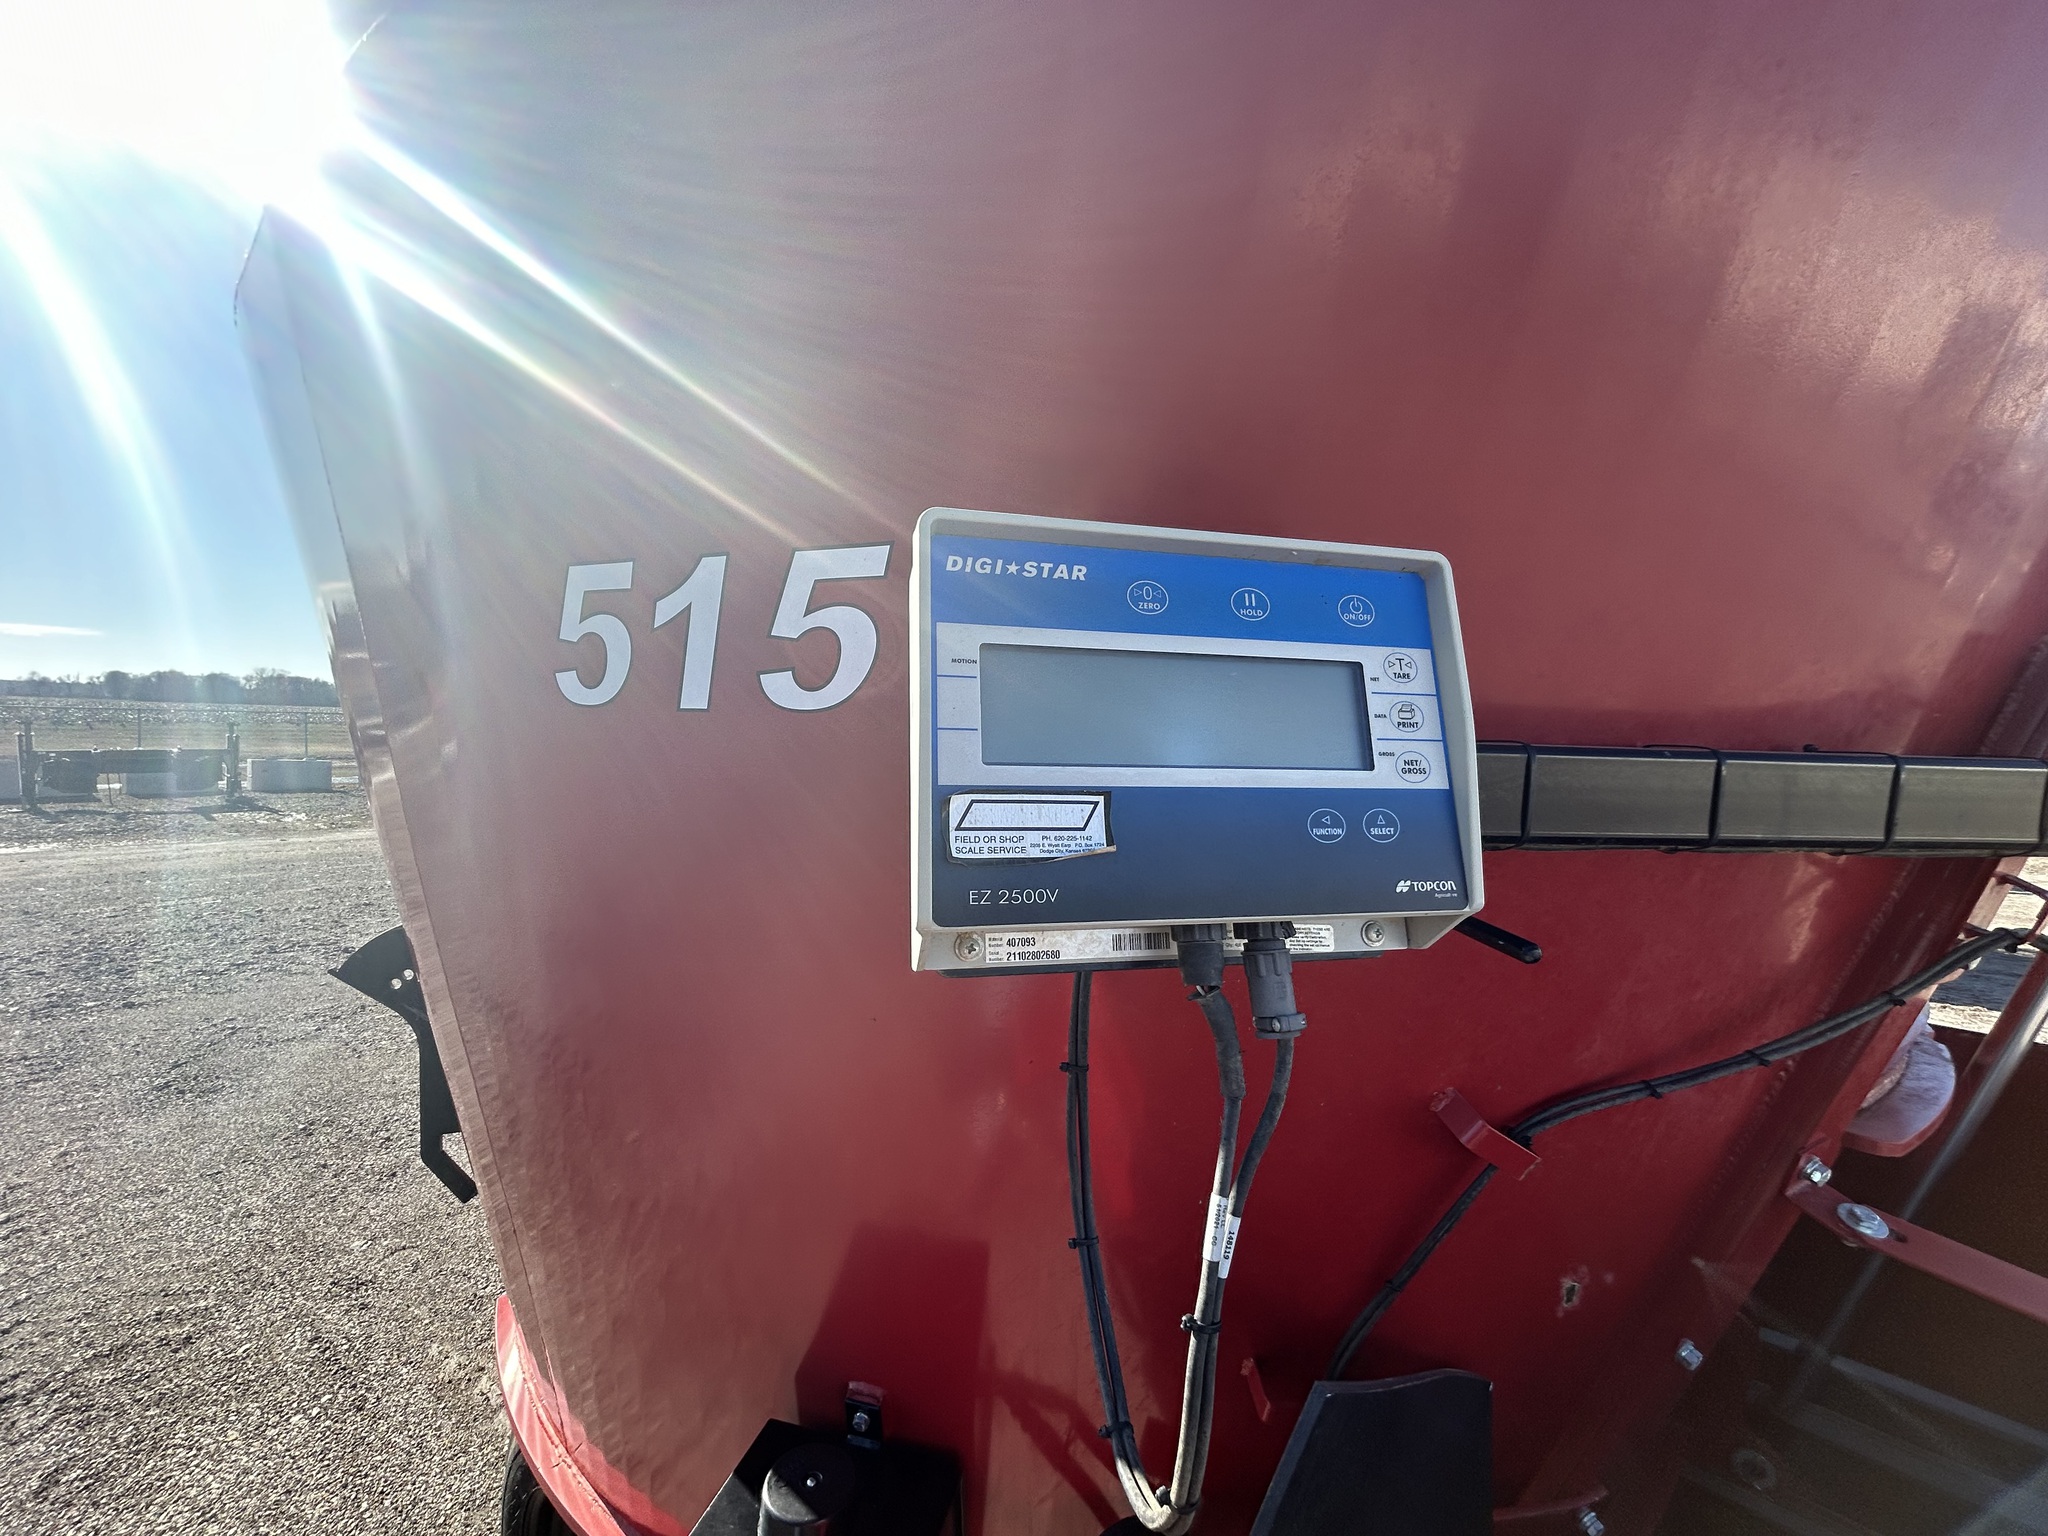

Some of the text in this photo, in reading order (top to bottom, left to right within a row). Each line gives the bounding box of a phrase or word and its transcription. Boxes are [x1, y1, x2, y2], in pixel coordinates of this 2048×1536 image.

[1138, 601, 1161, 611] ZERO
[1240, 608, 1263, 617] HOLD
[1343, 613, 1371, 622] ON/OFF
[554, 543, 891, 711] 515
[951, 657, 978, 665] MOTION
[1393, 672, 1411, 680] TARE
[1397, 721, 1419, 729] PRINT
[1403, 759, 1422, 767] NET/
[1401, 767, 1427, 775] GROSS
[1312, 827, 1343, 836] FUNCTION
[1370, 827, 1395, 835] SELECT
[954, 835, 1025, 844] FIELD OR SHOP
[954, 846, 1027, 855] SCALE SERVICE
[1411, 880, 1457, 892] TOPCON
[969, 888, 1059, 905] EZ 2500V
[1006, 936, 1036, 948] 407093
[1006, 949, 1061, 962] 21102802680
[1222, 1230, 1236, 1260] 148119
